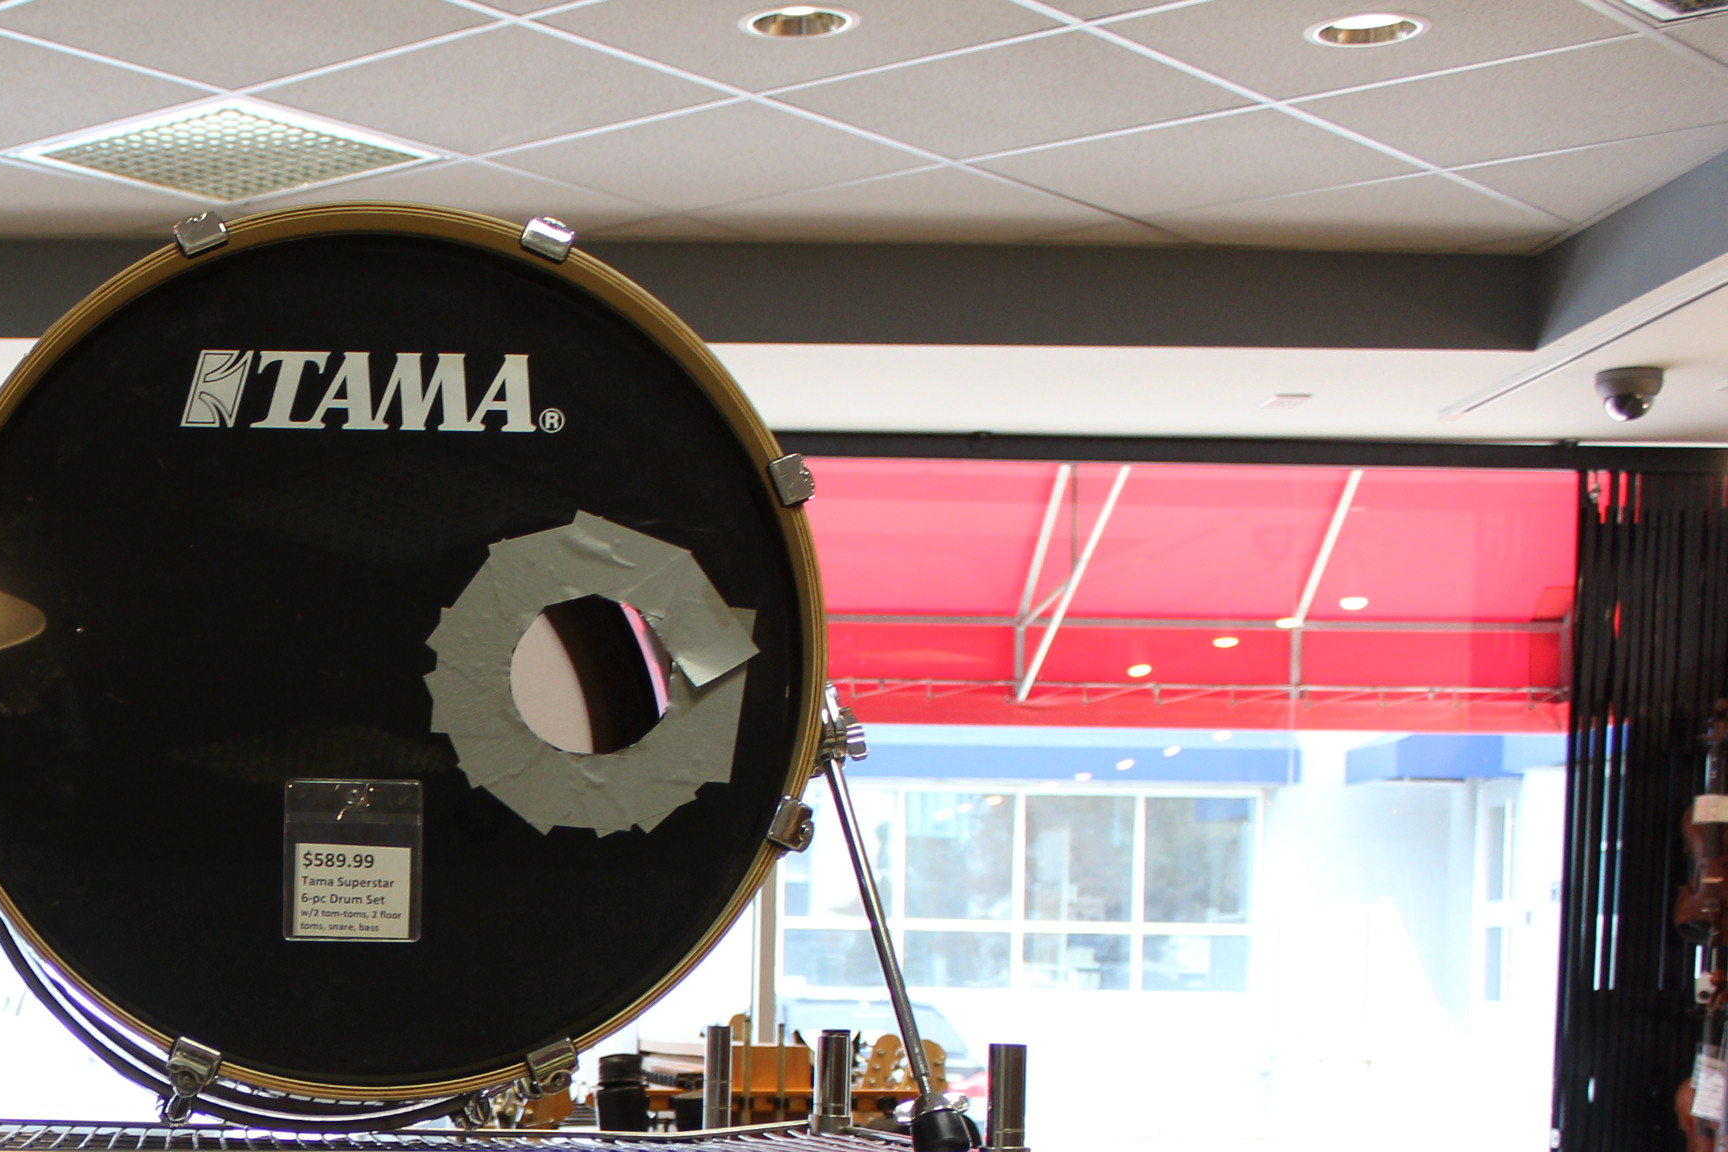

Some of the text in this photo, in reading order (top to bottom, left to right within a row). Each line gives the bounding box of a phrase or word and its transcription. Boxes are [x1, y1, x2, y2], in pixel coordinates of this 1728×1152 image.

[249, 350, 537, 432] TAMA
[302, 851, 375, 869] $589.99
[302, 875, 395, 889] Tama Superstar
[301, 893, 386, 905] 6-pc Drum Set
[300, 908, 402, 919] w/2 tom-toms, 2 floor
[300, 922, 380, 932] toms, snare, bass
